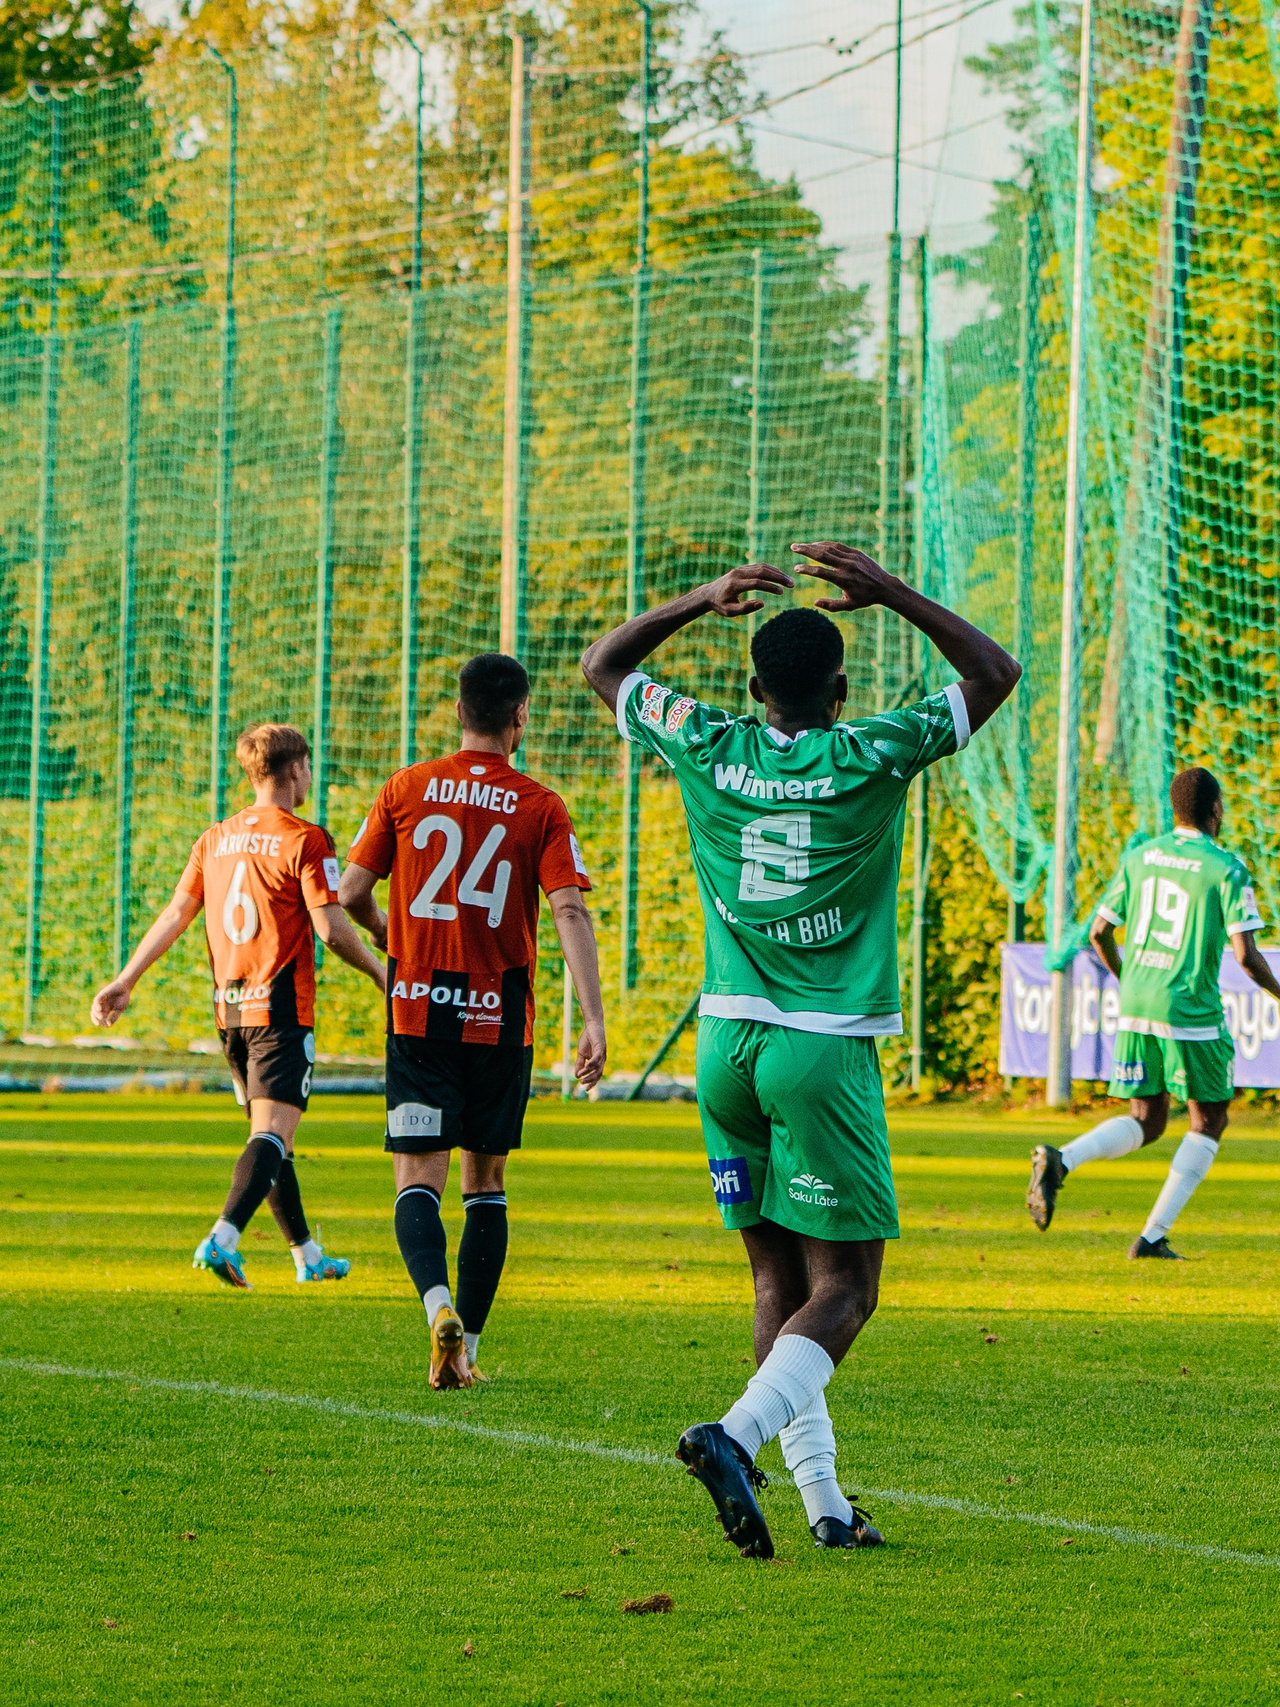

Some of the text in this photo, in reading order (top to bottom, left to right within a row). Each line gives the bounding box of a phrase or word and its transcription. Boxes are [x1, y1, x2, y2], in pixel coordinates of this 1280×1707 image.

[423, 777, 519, 815] ADAMEC
[714, 762, 836, 800] Winnerz
[409, 814, 512, 929] 24
[738, 811, 812, 902] 8
[1143, 847, 1203, 873] Winnerz
[223, 861, 259, 946] 6
[1134, 875, 1190, 951] 19
[797, 906, 843, 945] BAH
[391, 980, 502, 1010] APOLLO
[301, 1064, 313, 1099] 6
[395, 1115, 433, 1127] LIDO
[788, 1186, 839, 1207] Saku Läte
